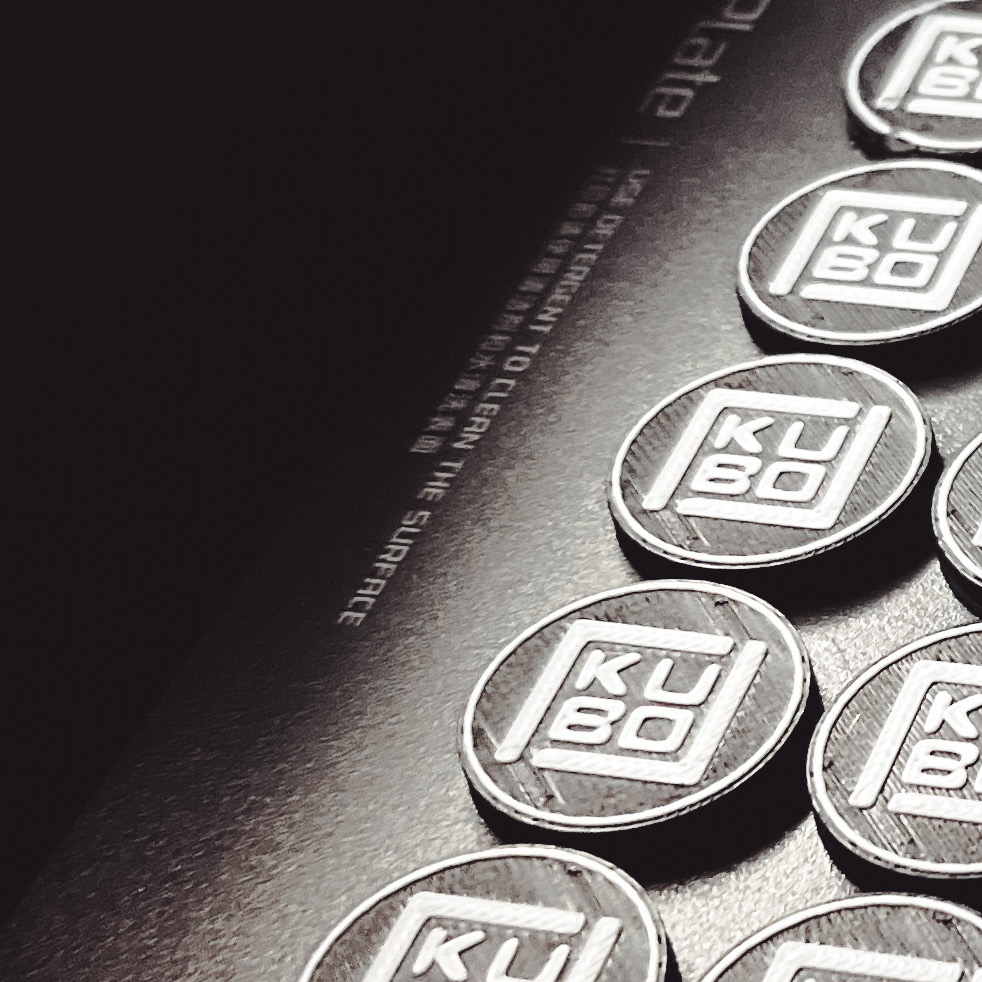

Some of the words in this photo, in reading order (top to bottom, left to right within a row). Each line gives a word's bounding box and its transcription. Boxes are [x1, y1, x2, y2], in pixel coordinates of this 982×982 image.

[609, 169, 651, 206] USE
[832, 211, 958, 252] KU
[528, 214, 625, 332] DETERGENT
[811, 243, 939, 288] BO
[502, 344, 541, 372] TO
[450, 377, 517, 450] CLEAN
[709, 412, 850, 461] KU
[416, 460, 466, 501] THE
[688, 453, 827, 502] BO
[336, 510, 432, 627] SURFACE
[574, 649, 723, 705] KU
[546, 695, 696, 753] BO
